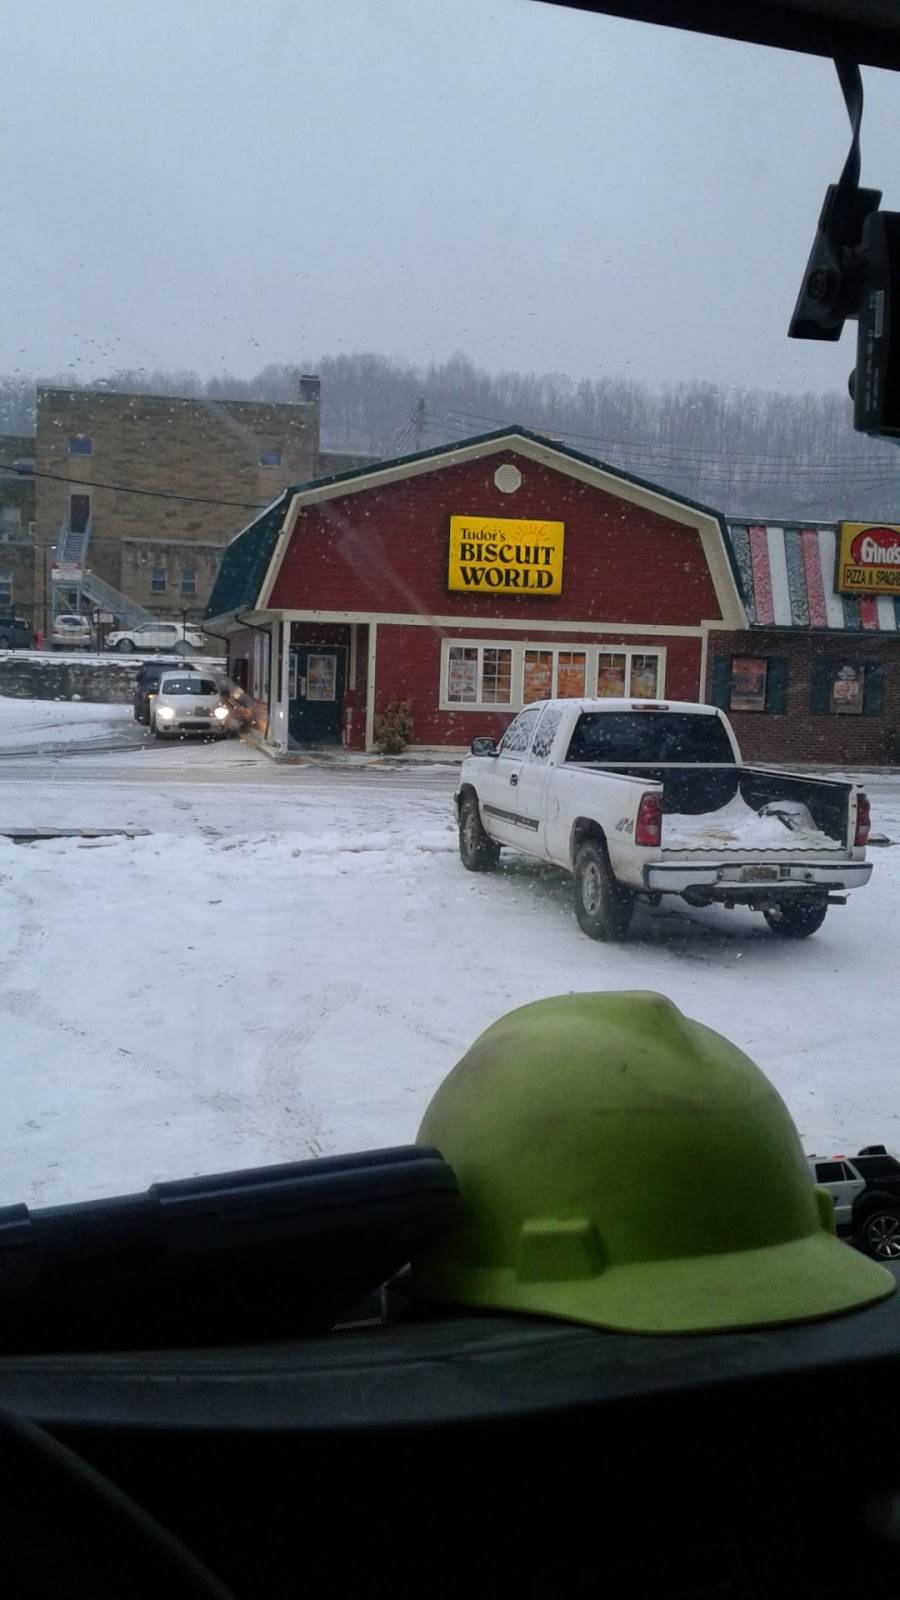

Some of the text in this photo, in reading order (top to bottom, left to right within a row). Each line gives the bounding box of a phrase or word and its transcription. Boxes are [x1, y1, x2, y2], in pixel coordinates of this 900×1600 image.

[461, 527, 506, 542] Tudor's
[460, 542, 555, 565] BISCUIT
[459, 566, 553, 588] WORLD
[847, 569, 866, 584] PIZZA
